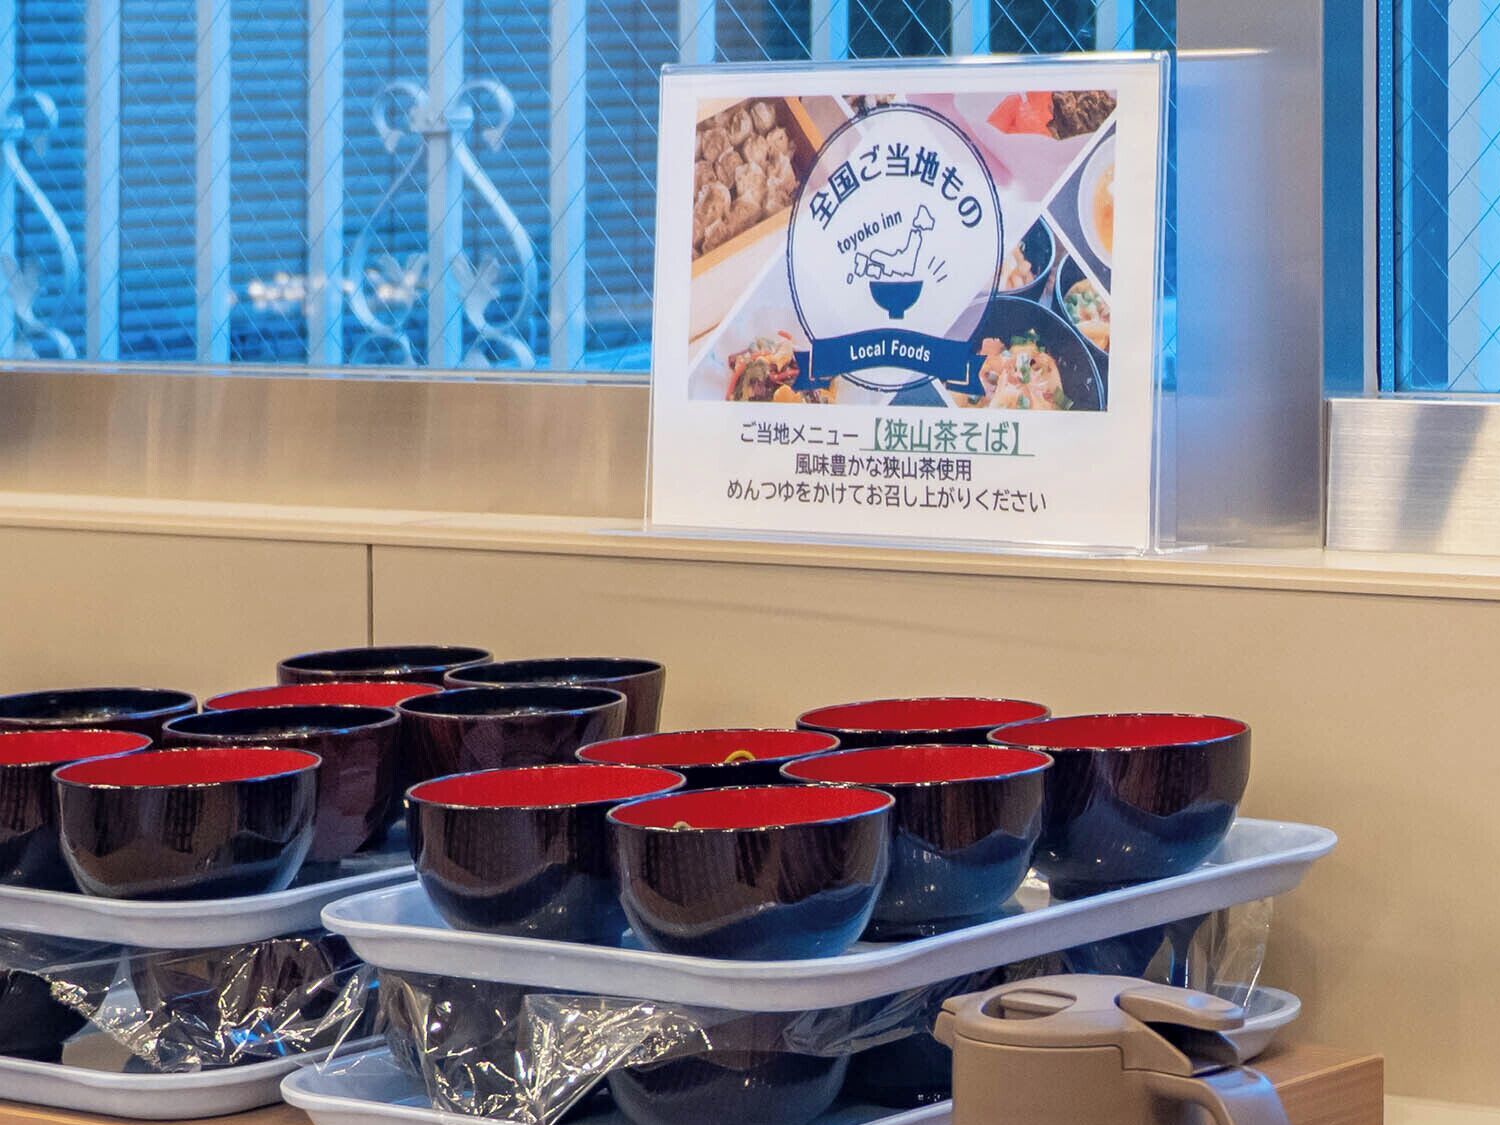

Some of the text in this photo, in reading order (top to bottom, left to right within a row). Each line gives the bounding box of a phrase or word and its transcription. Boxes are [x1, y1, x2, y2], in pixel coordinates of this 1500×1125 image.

[809, 142, 983, 230] 全国ご当地もの
[836, 210, 903, 254] toyoko inn
[850, 339, 931, 362] Local Foods
[794, 452, 973, 482] 風味豊かな狭山茶使用
[726, 478, 1047, 513] めんつゆをかけてお召し上がりください
